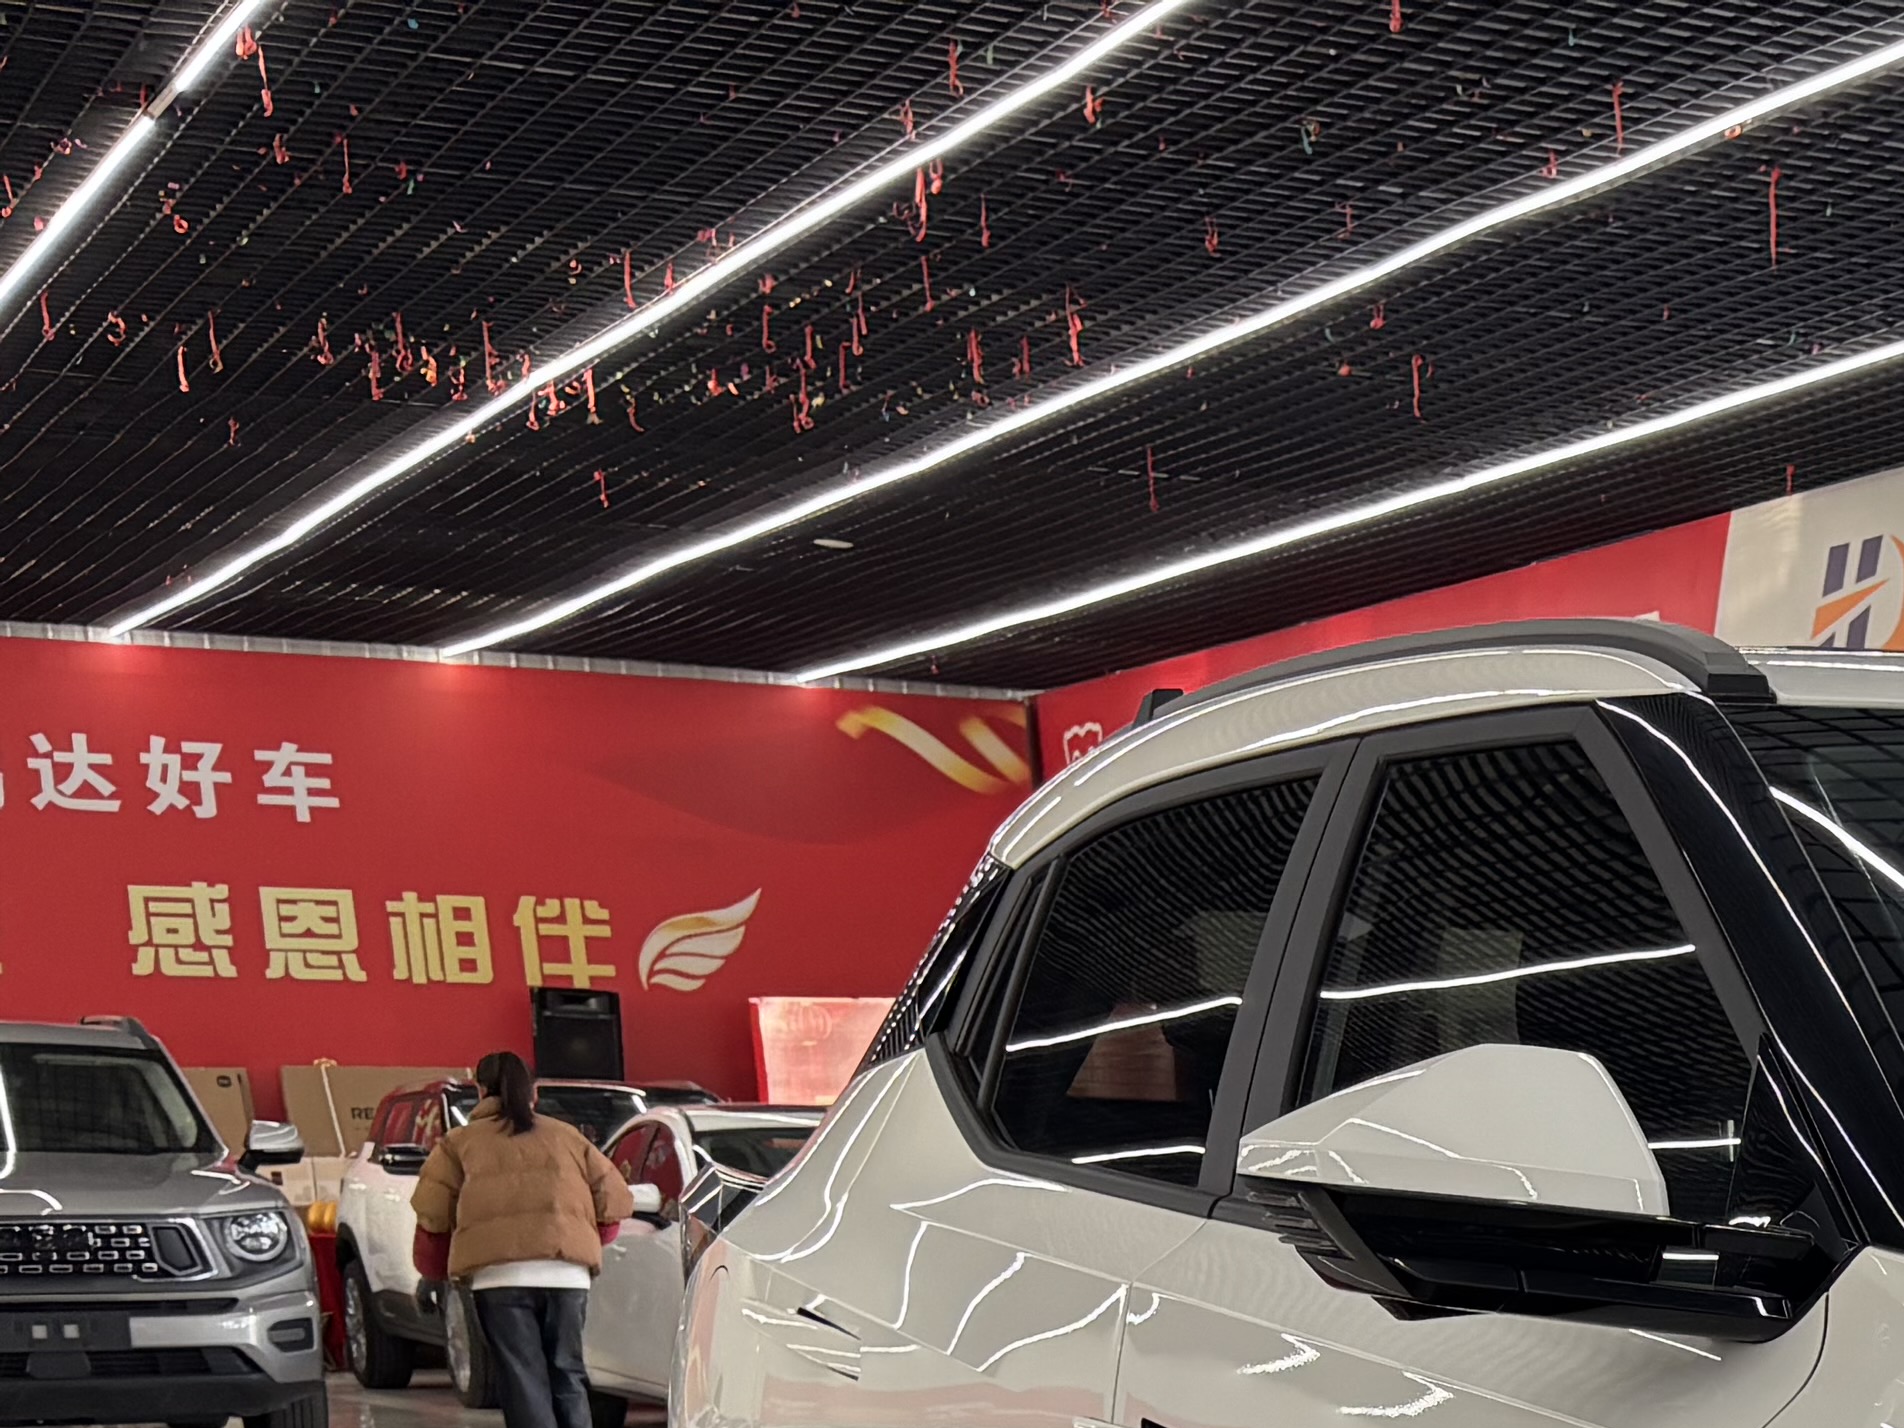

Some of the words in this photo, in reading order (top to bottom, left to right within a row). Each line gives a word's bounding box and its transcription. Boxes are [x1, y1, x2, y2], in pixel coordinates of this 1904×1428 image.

[0, 733, 341, 822] 达好车
[127, 881, 617, 988] 感恩相伴
